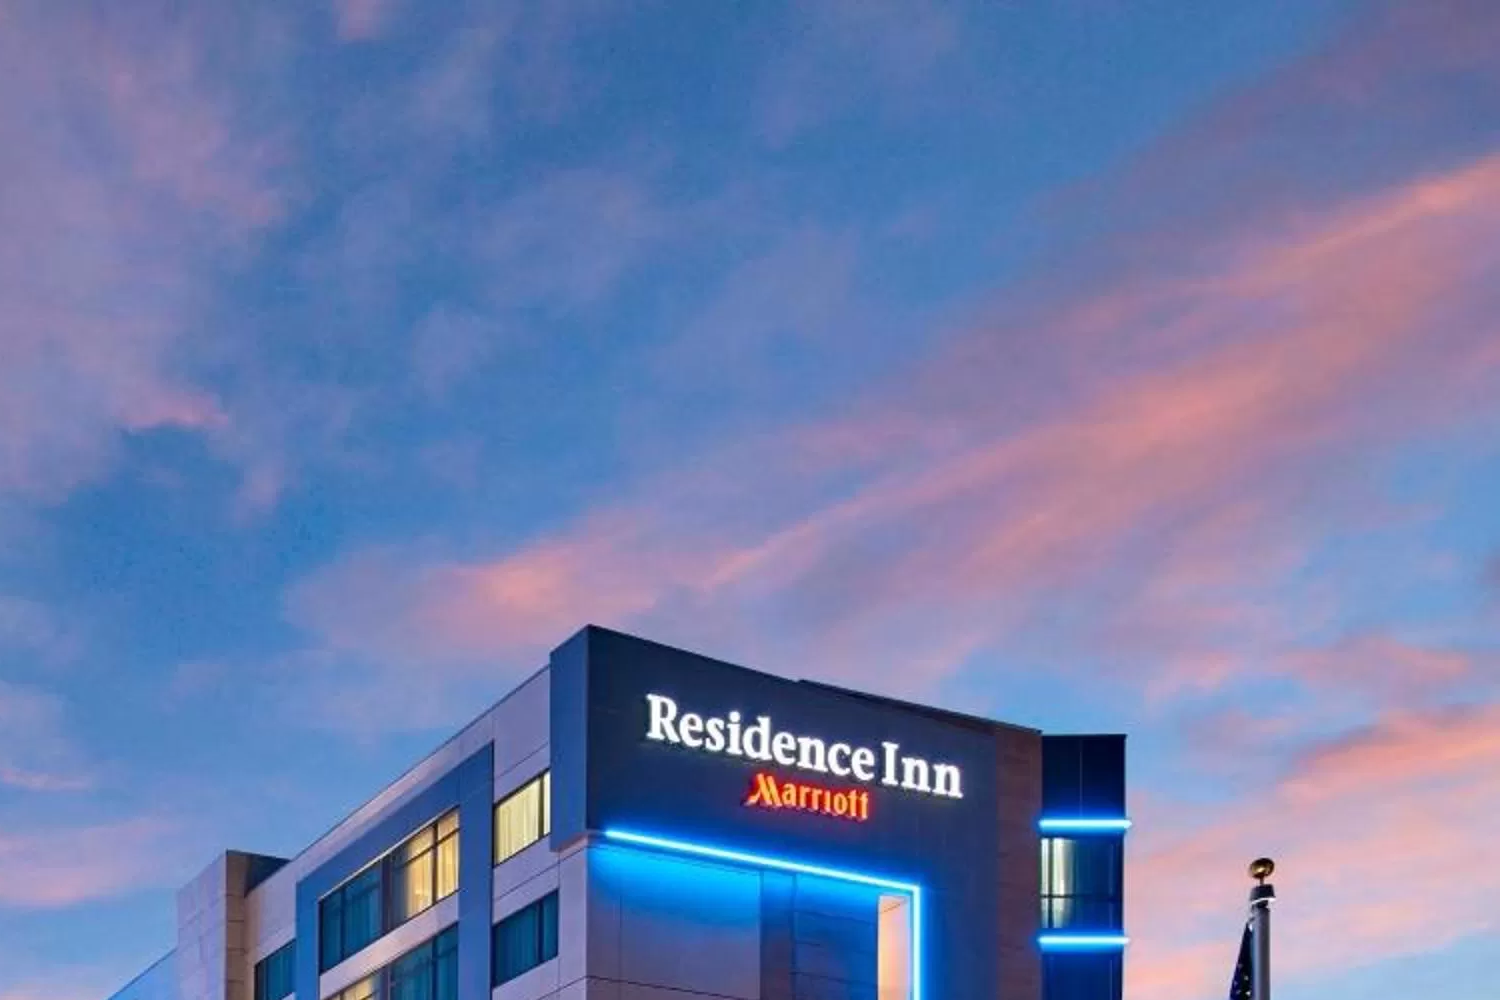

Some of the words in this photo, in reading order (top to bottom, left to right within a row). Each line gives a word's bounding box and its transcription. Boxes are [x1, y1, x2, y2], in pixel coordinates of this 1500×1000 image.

[646, 693, 875, 780] Residence
[881, 741, 963, 799] Inn
[744, 773, 869, 820] Marriott
